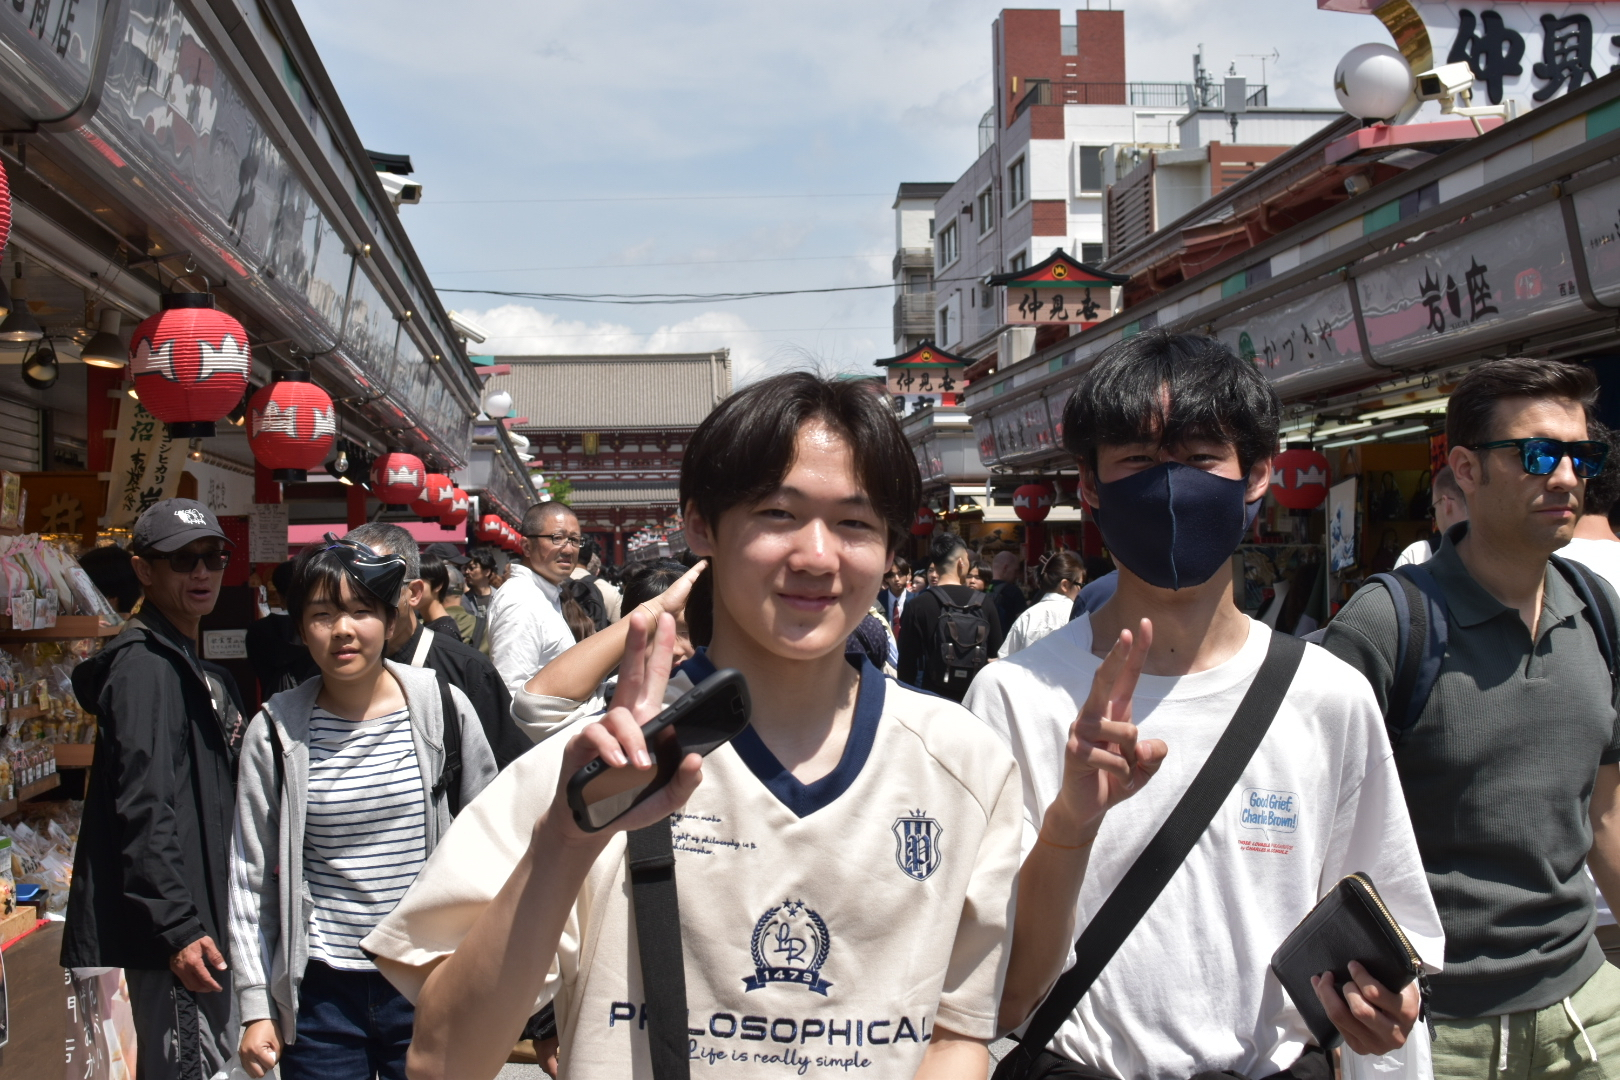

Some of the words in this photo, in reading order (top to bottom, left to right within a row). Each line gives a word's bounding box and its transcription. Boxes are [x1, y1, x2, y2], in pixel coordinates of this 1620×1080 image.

[1447, 9, 1620, 104] 仲見
[1018, 287, 1101, 321] 仲見世
[896, 367, 956, 392] 仲見世
[1250, 792, 1269, 808] Good
[701, 815, 722, 823] make
[1242, 808, 1267, 825] Charlie
[1268, 811, 1297, 828] Brown!
[702, 836, 740, 850] philosophy
[763, 970, 813, 982] 1479
[689, 1038, 727, 1065] Life
[731, 1049, 748, 1062] is
[754, 1048, 811, 1075] really
[816, 1050, 872, 1072] simple
